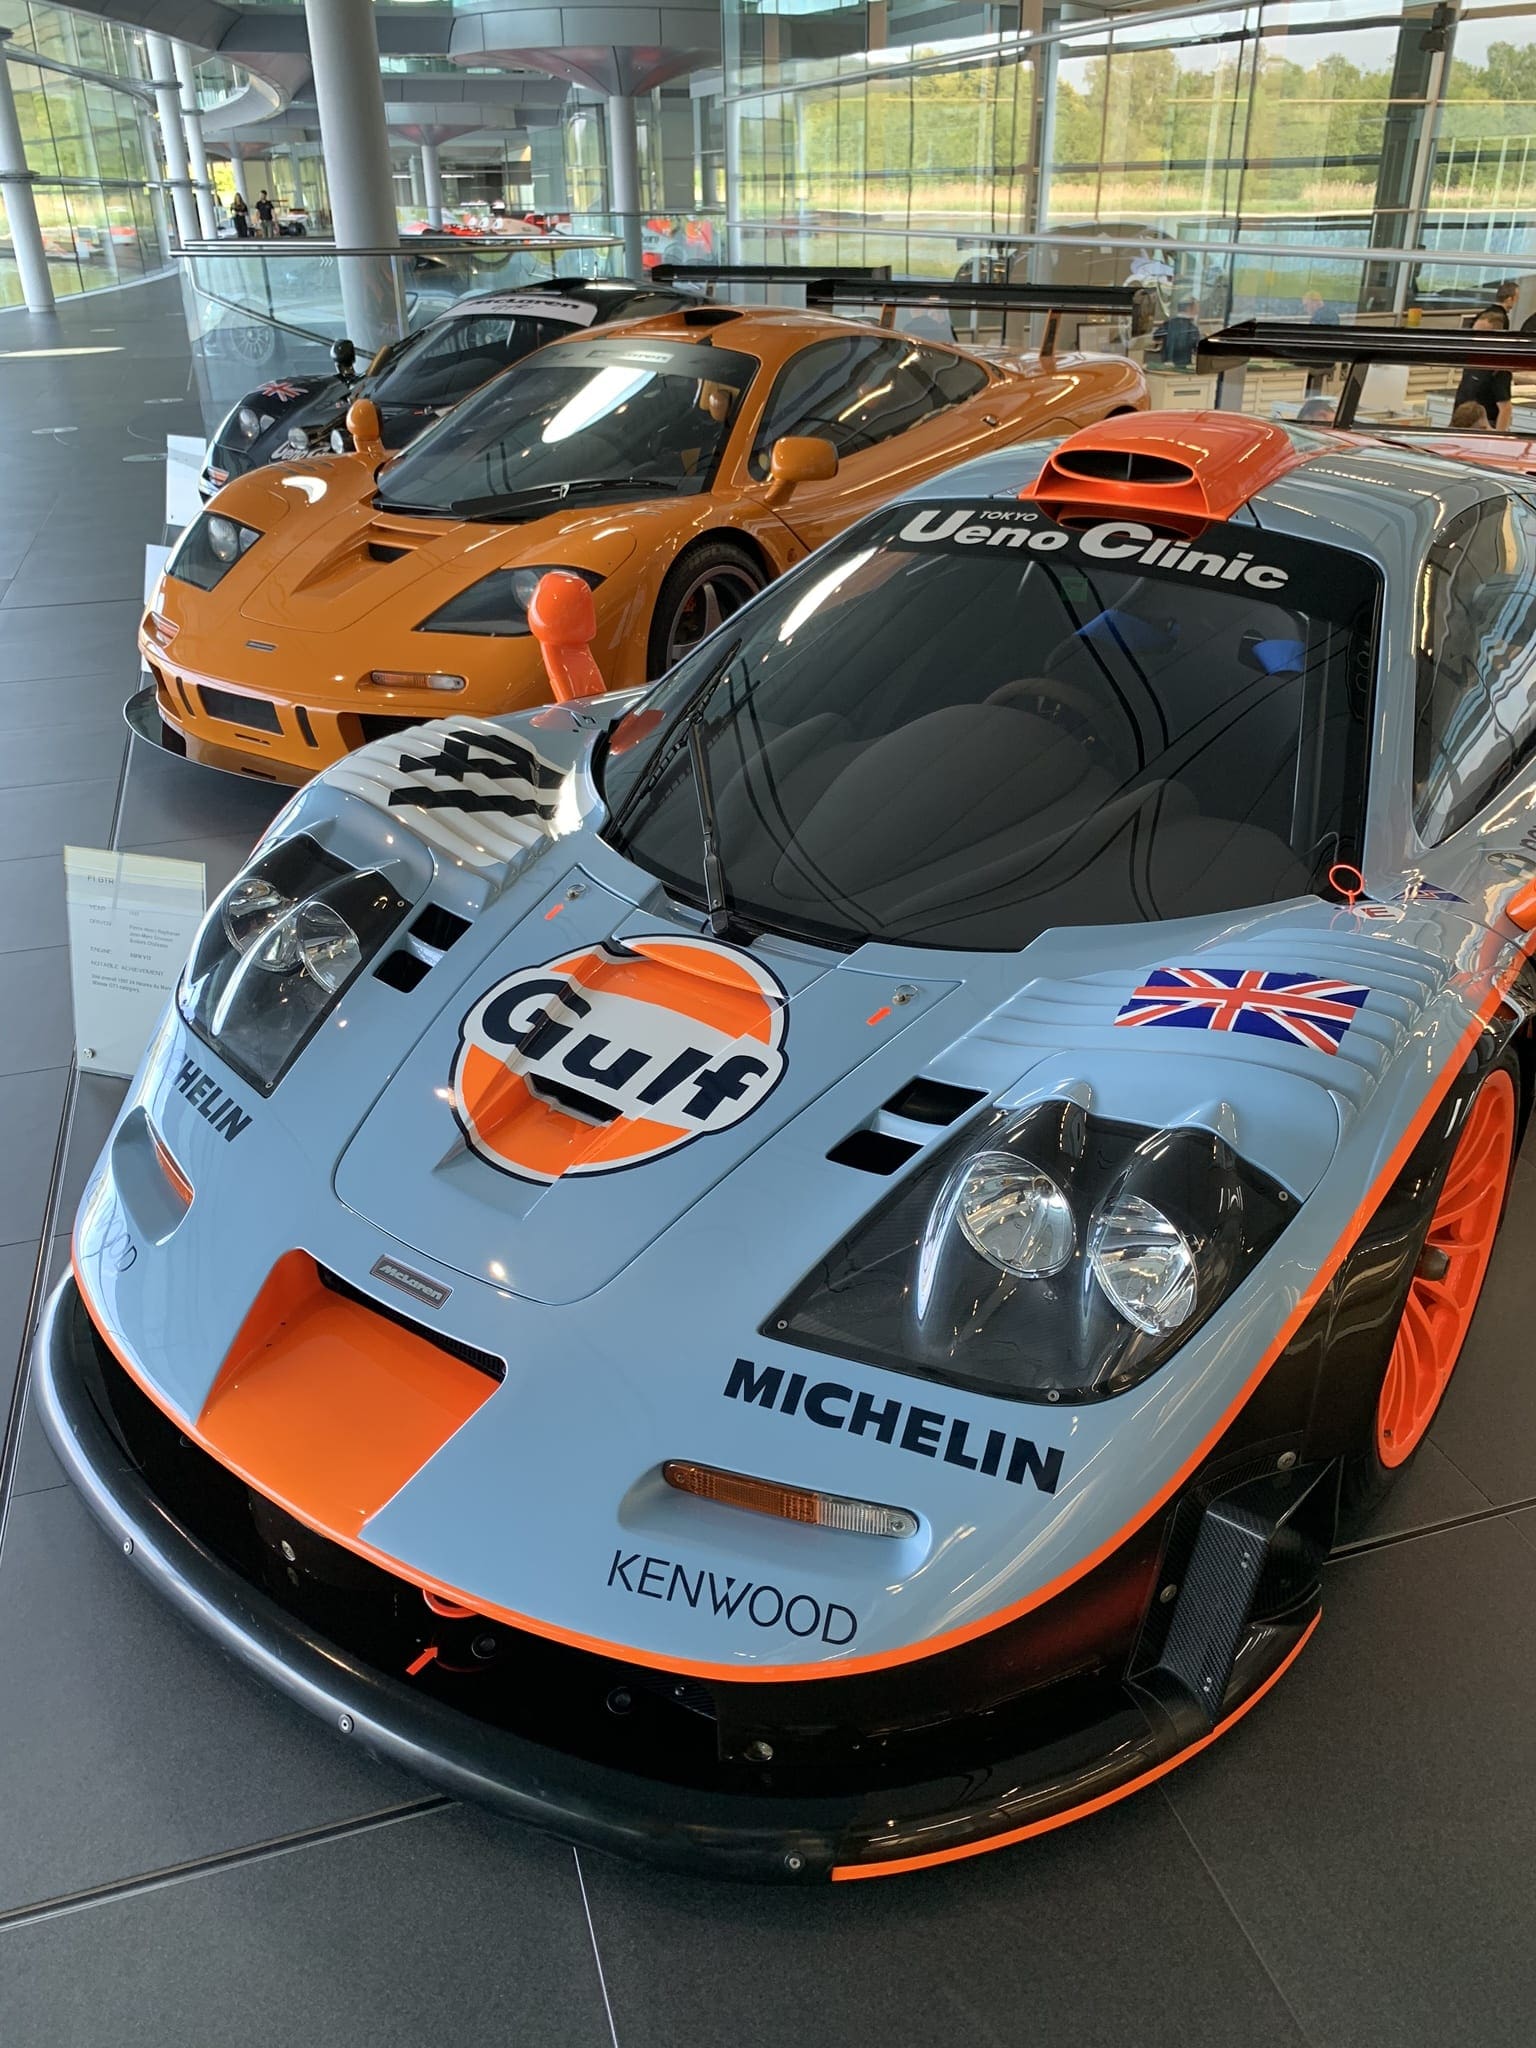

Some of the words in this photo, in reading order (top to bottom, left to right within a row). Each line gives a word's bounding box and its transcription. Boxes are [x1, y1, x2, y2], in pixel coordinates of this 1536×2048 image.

[899, 509, 1070, 552] Ueno
[1078, 521, 1290, 590] Clinic
[979, 510, 1040, 522] TOKYO
[482, 979, 770, 1121] Gulf
[174, 1055, 253, 1143] HELIN
[379, 1264, 443, 1301] McLaren
[723, 1358, 1065, 1495] MICHELIN
[607, 1550, 858, 1646] KENWOOD
